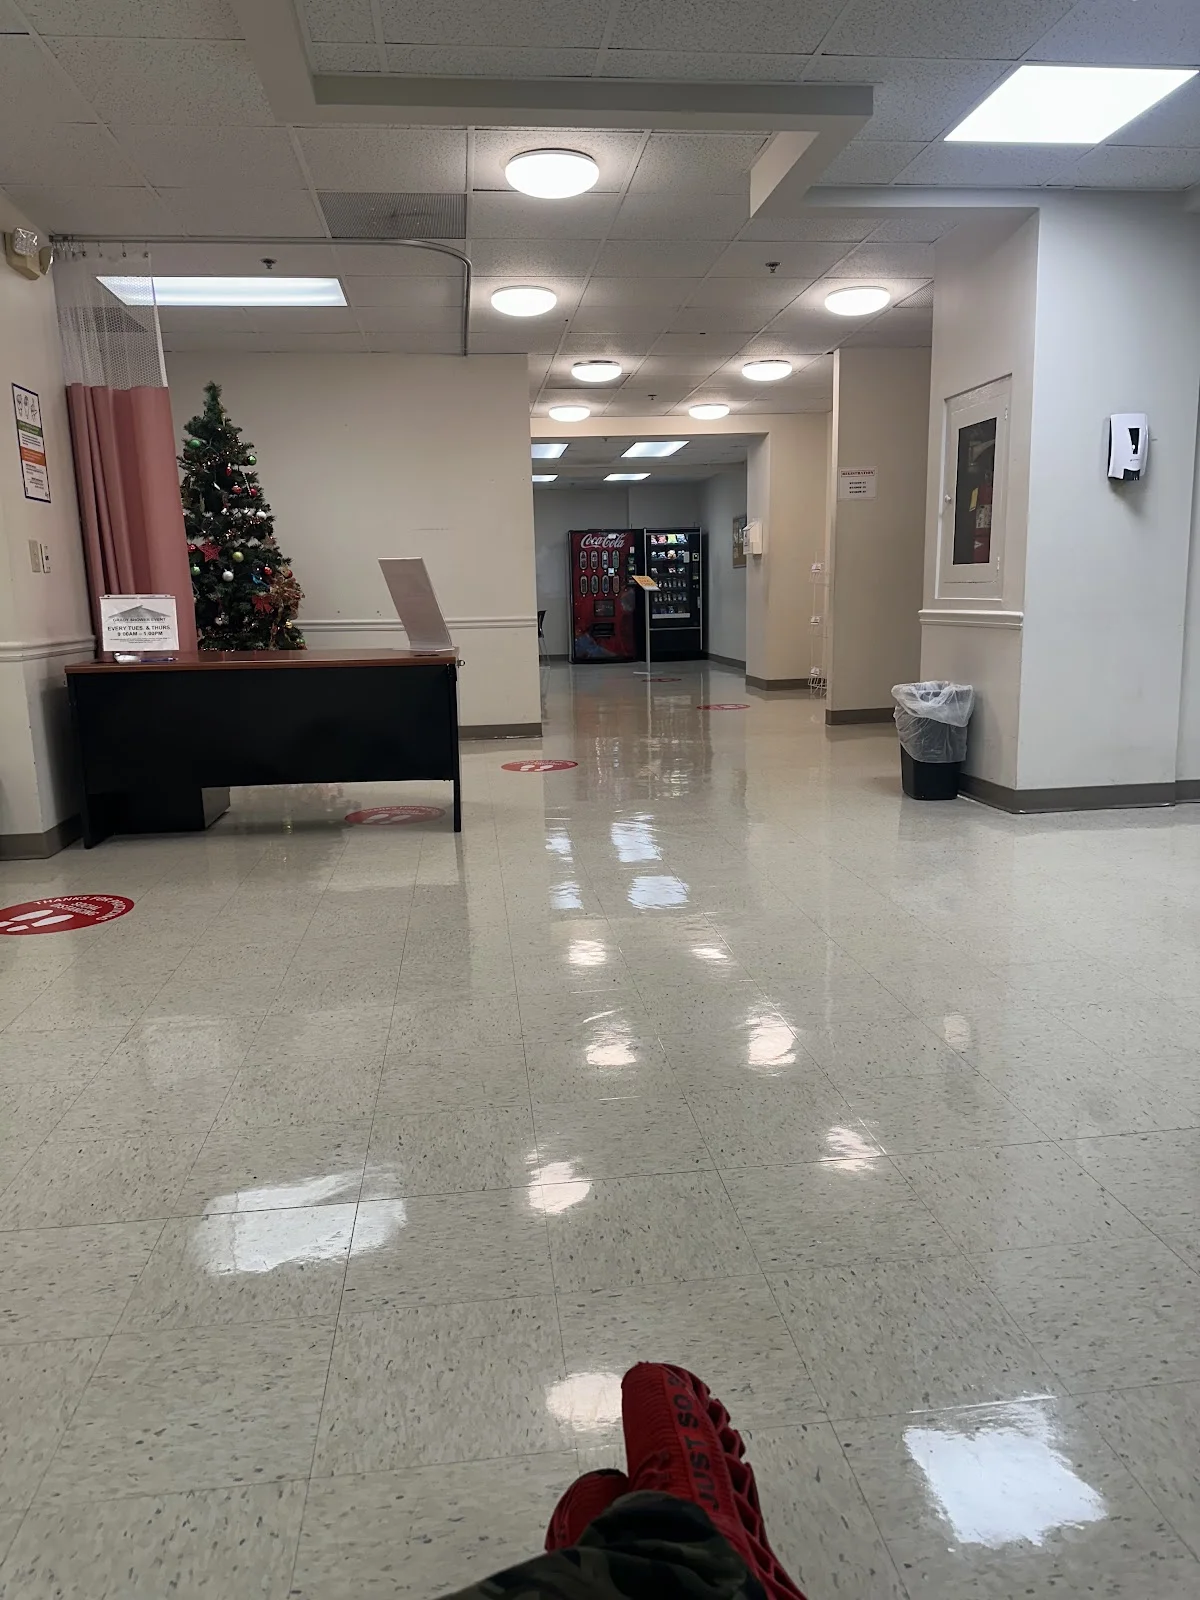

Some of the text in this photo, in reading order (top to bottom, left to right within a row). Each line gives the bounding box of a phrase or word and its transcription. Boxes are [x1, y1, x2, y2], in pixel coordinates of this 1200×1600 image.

[33, 896, 90, 905] THANKS
[673, 1394, 699, 1429] SO
[684, 1435, 719, 1511] JUST
